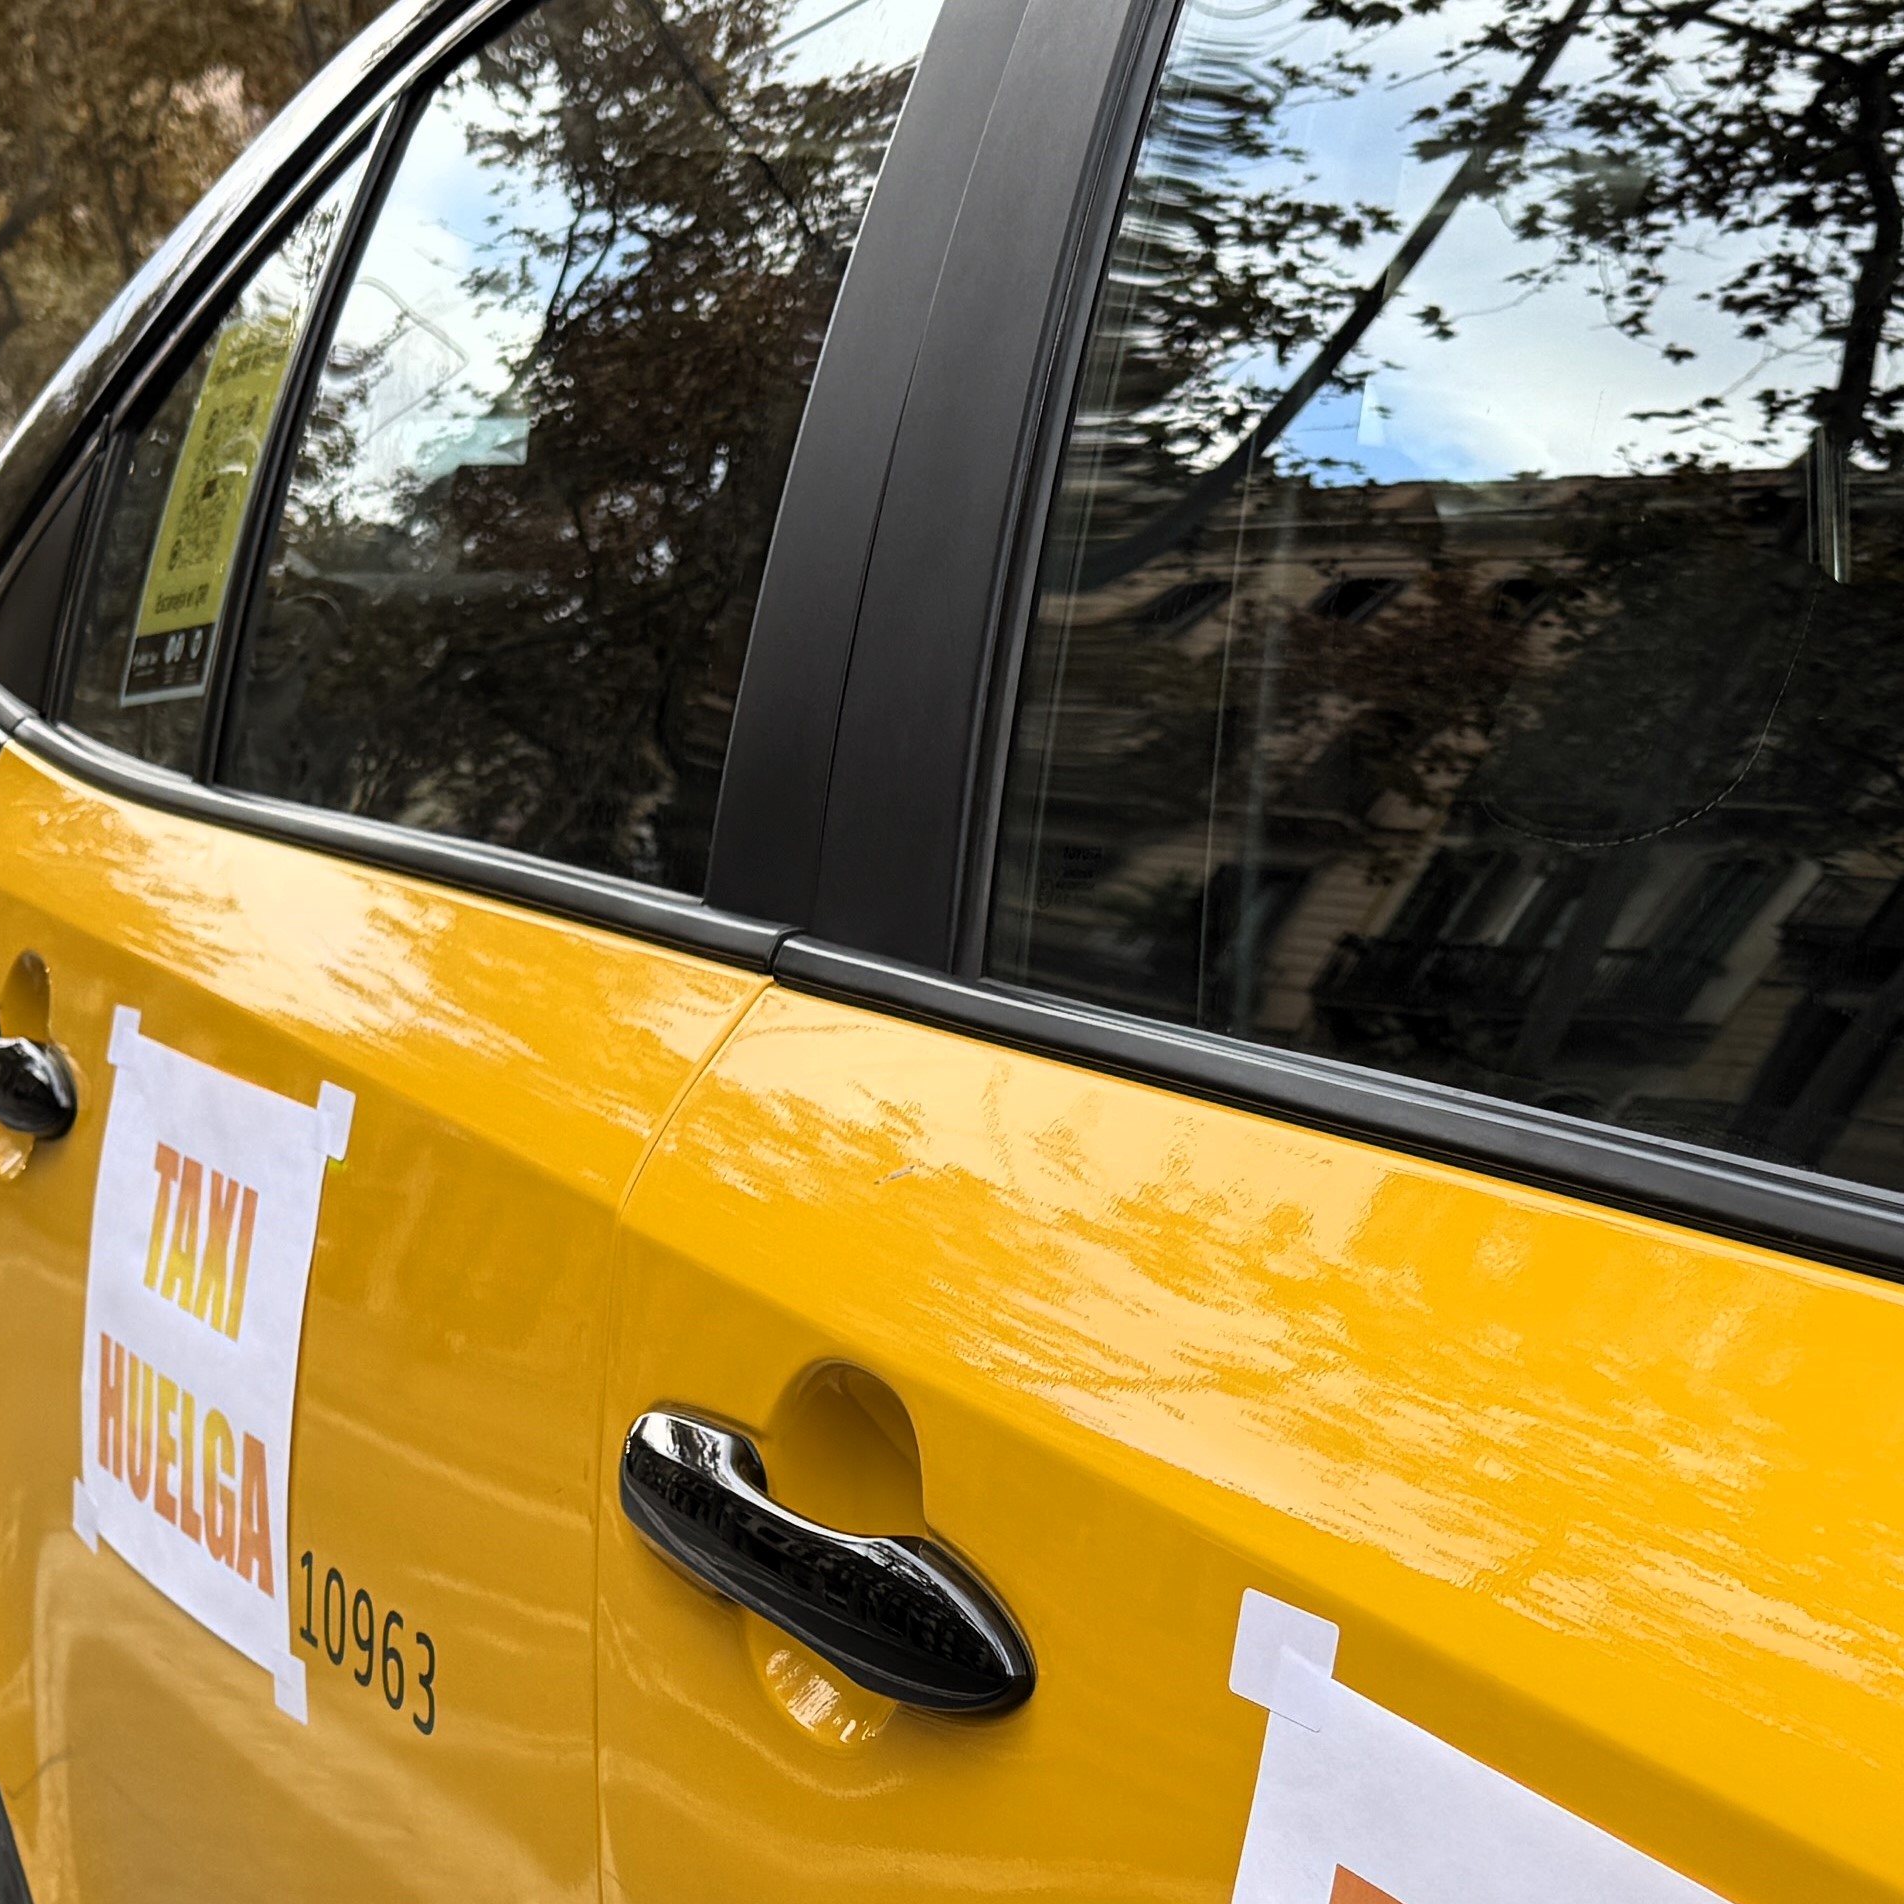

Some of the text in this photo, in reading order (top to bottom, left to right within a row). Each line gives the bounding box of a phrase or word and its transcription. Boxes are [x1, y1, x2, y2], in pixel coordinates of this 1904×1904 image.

[144, 1141, 258, 1342] TAXI
[98, 1331, 275, 1600] HUELGA
[299, 1550, 436, 1735] 10963
